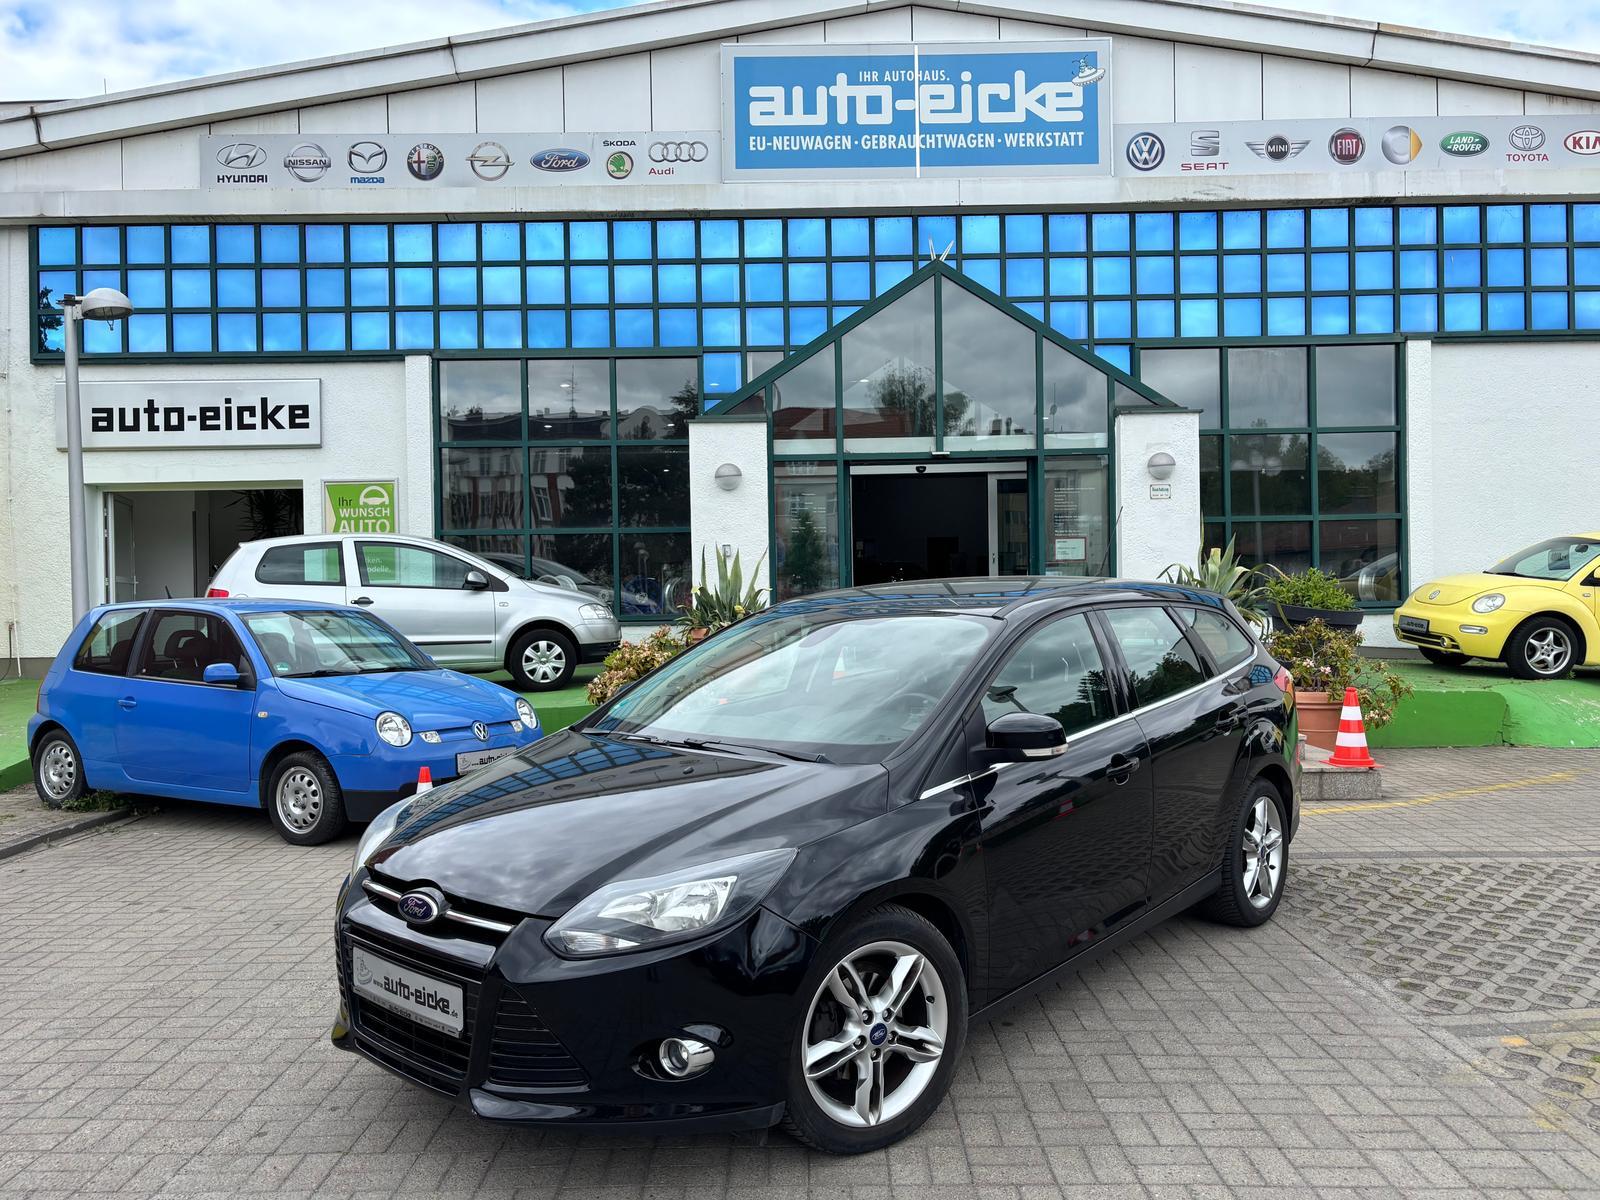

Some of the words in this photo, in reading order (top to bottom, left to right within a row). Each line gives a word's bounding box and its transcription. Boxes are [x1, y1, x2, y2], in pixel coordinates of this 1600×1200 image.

[859, 70, 879, 82] IHR
[749, 70, 1083, 126] auto-eicke
[749, 134, 851, 151] EU-NEUWAGEN
[861, 132, 994, 149] GEBRAUCHTWAGEN
[1004, 131, 1084, 147] WERKSTATT
[1268, 144, 1288, 153] MINI
[1337, 139, 1357, 155] FIAT
[288, 159, 327, 167] NISSAN
[541, 152, 579, 168] Ford
[1506, 154, 1549, 162] TOYOTA
[649, 167, 675, 176] Audi
[1181, 163, 1229, 171] SEAT
[217, 175, 268, 183] HYUNDAI
[91, 397, 310, 432] auto-eicke
[338, 497, 352, 506] Ihr
[340, 507, 390, 518] WUNSCH
[340, 519, 390, 533] AUTO
